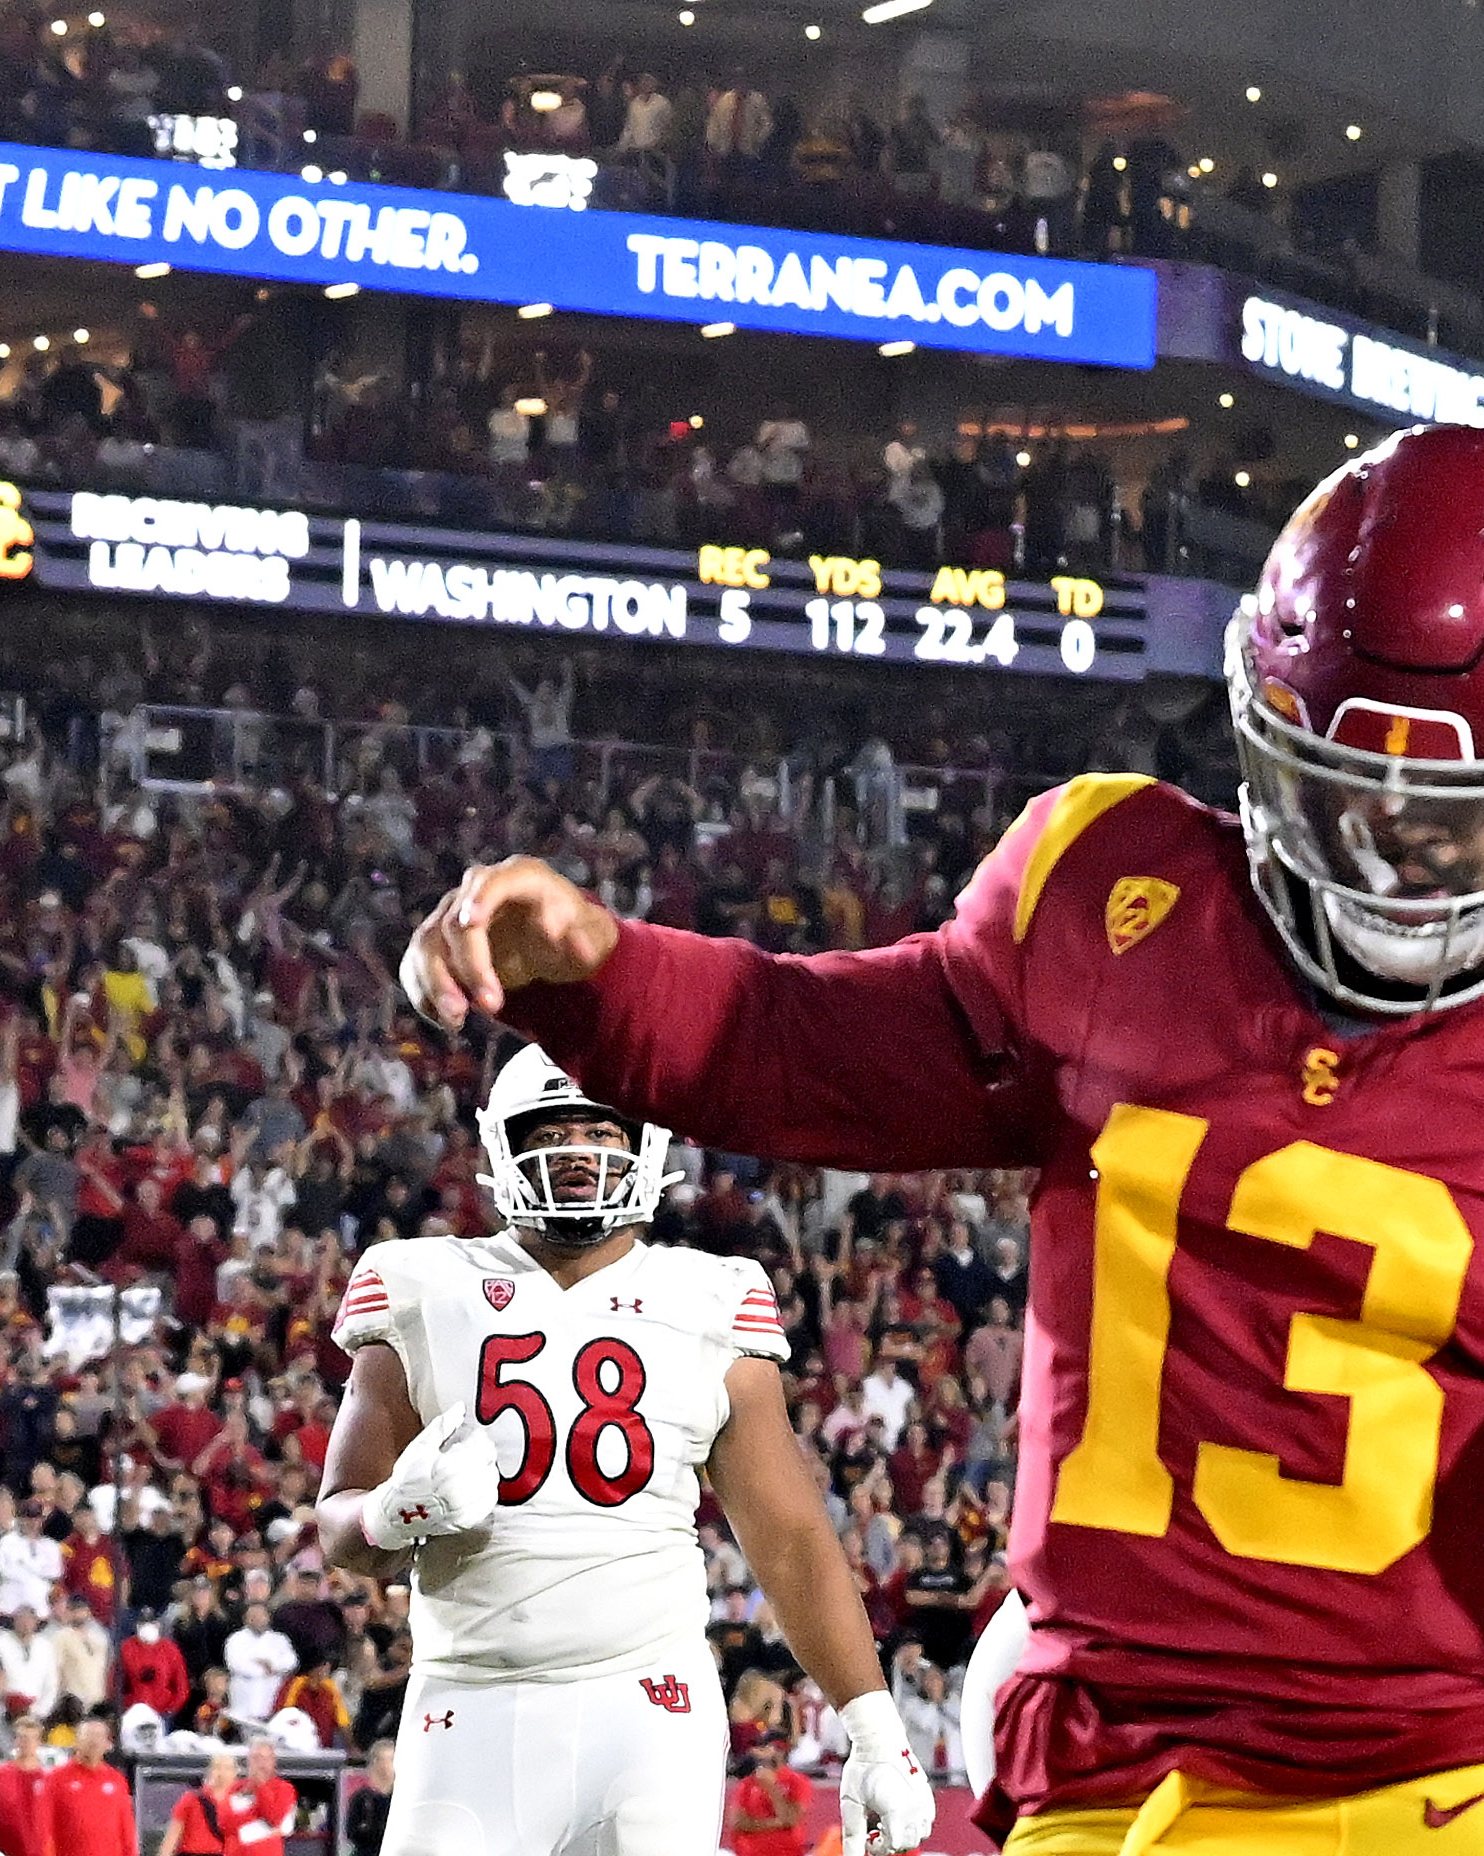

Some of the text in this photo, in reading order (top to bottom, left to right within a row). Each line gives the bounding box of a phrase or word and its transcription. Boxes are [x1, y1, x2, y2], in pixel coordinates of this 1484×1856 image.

[21, 168, 158, 239] LIKE
[162, 185, 260, 249] NO
[268, 196, 479, 274] OTHER.
[626, 234, 1074, 337] TERRANEA.COM
[369, 558, 1096, 673] WASHINGTON 5 112 22.4 0
[698, 545, 1104, 618] REC YDS AVG TD
[1049, 1102, 1475, 1576] 13
[475, 1330, 656, 1508] 58
